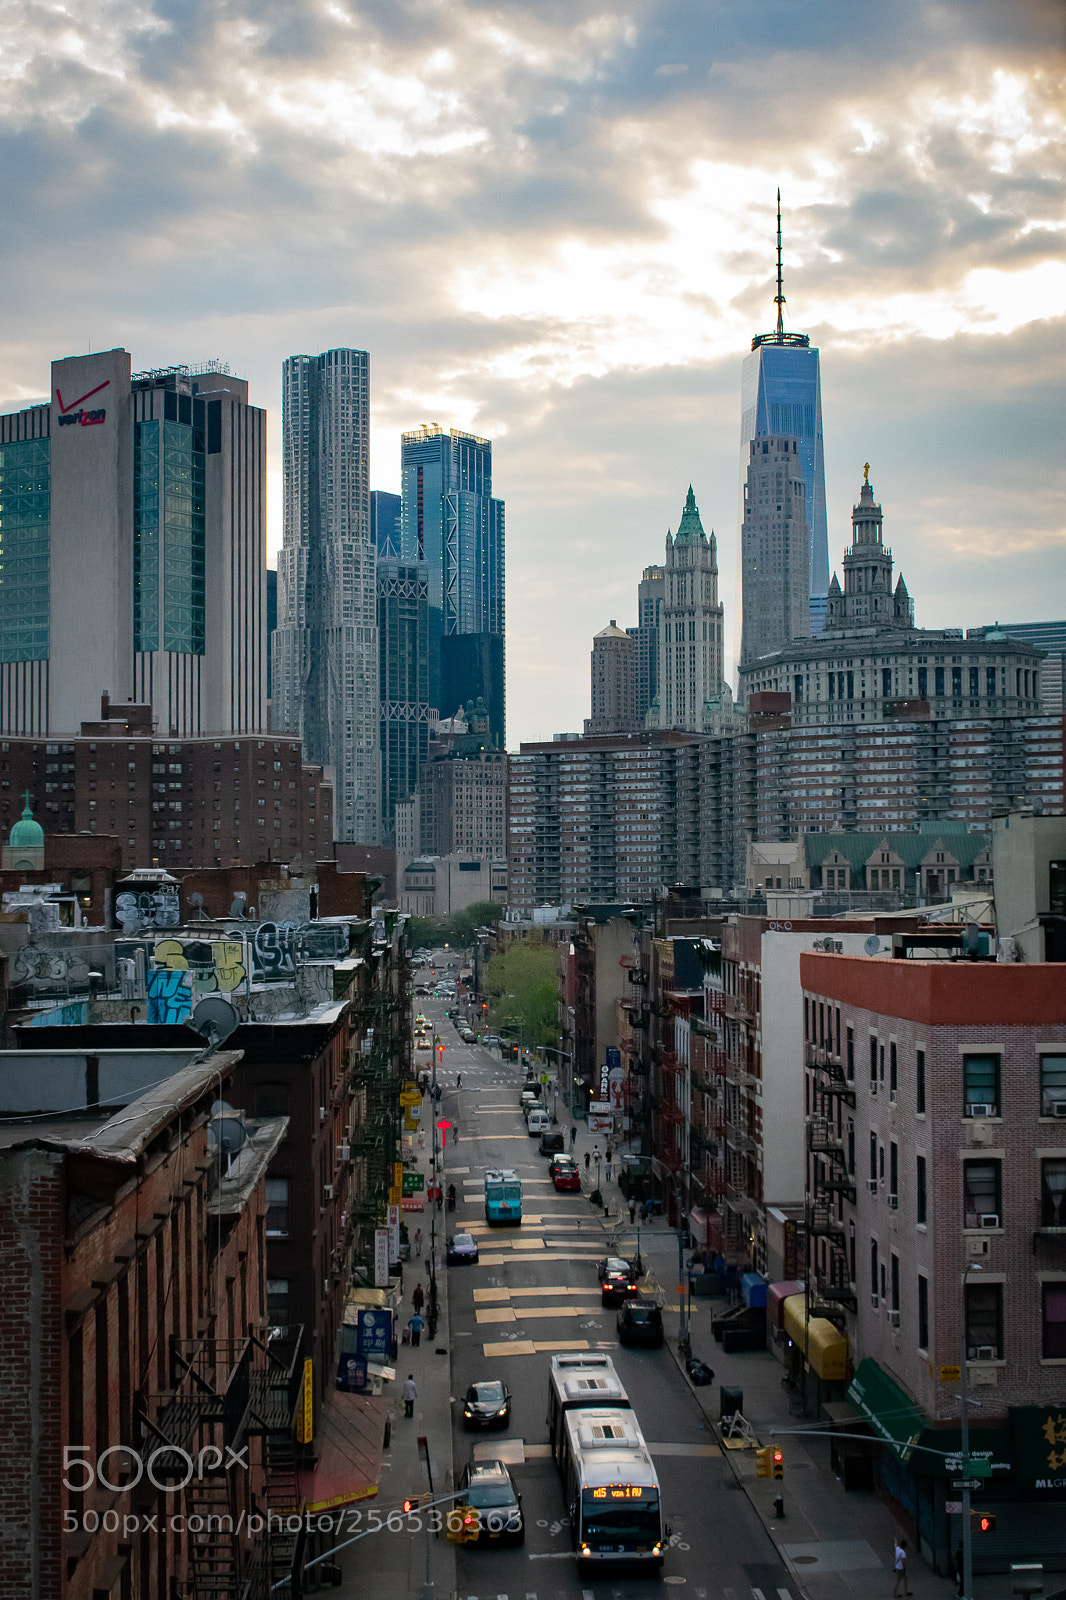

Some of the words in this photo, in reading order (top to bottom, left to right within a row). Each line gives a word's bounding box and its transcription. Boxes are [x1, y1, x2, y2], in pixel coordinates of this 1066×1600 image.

[58, 409, 106, 426] verizon
[593, 1487, 607, 1498] M15
[625, 1488, 630, 1497] 1
[631, 1487, 642, 1497] AV
